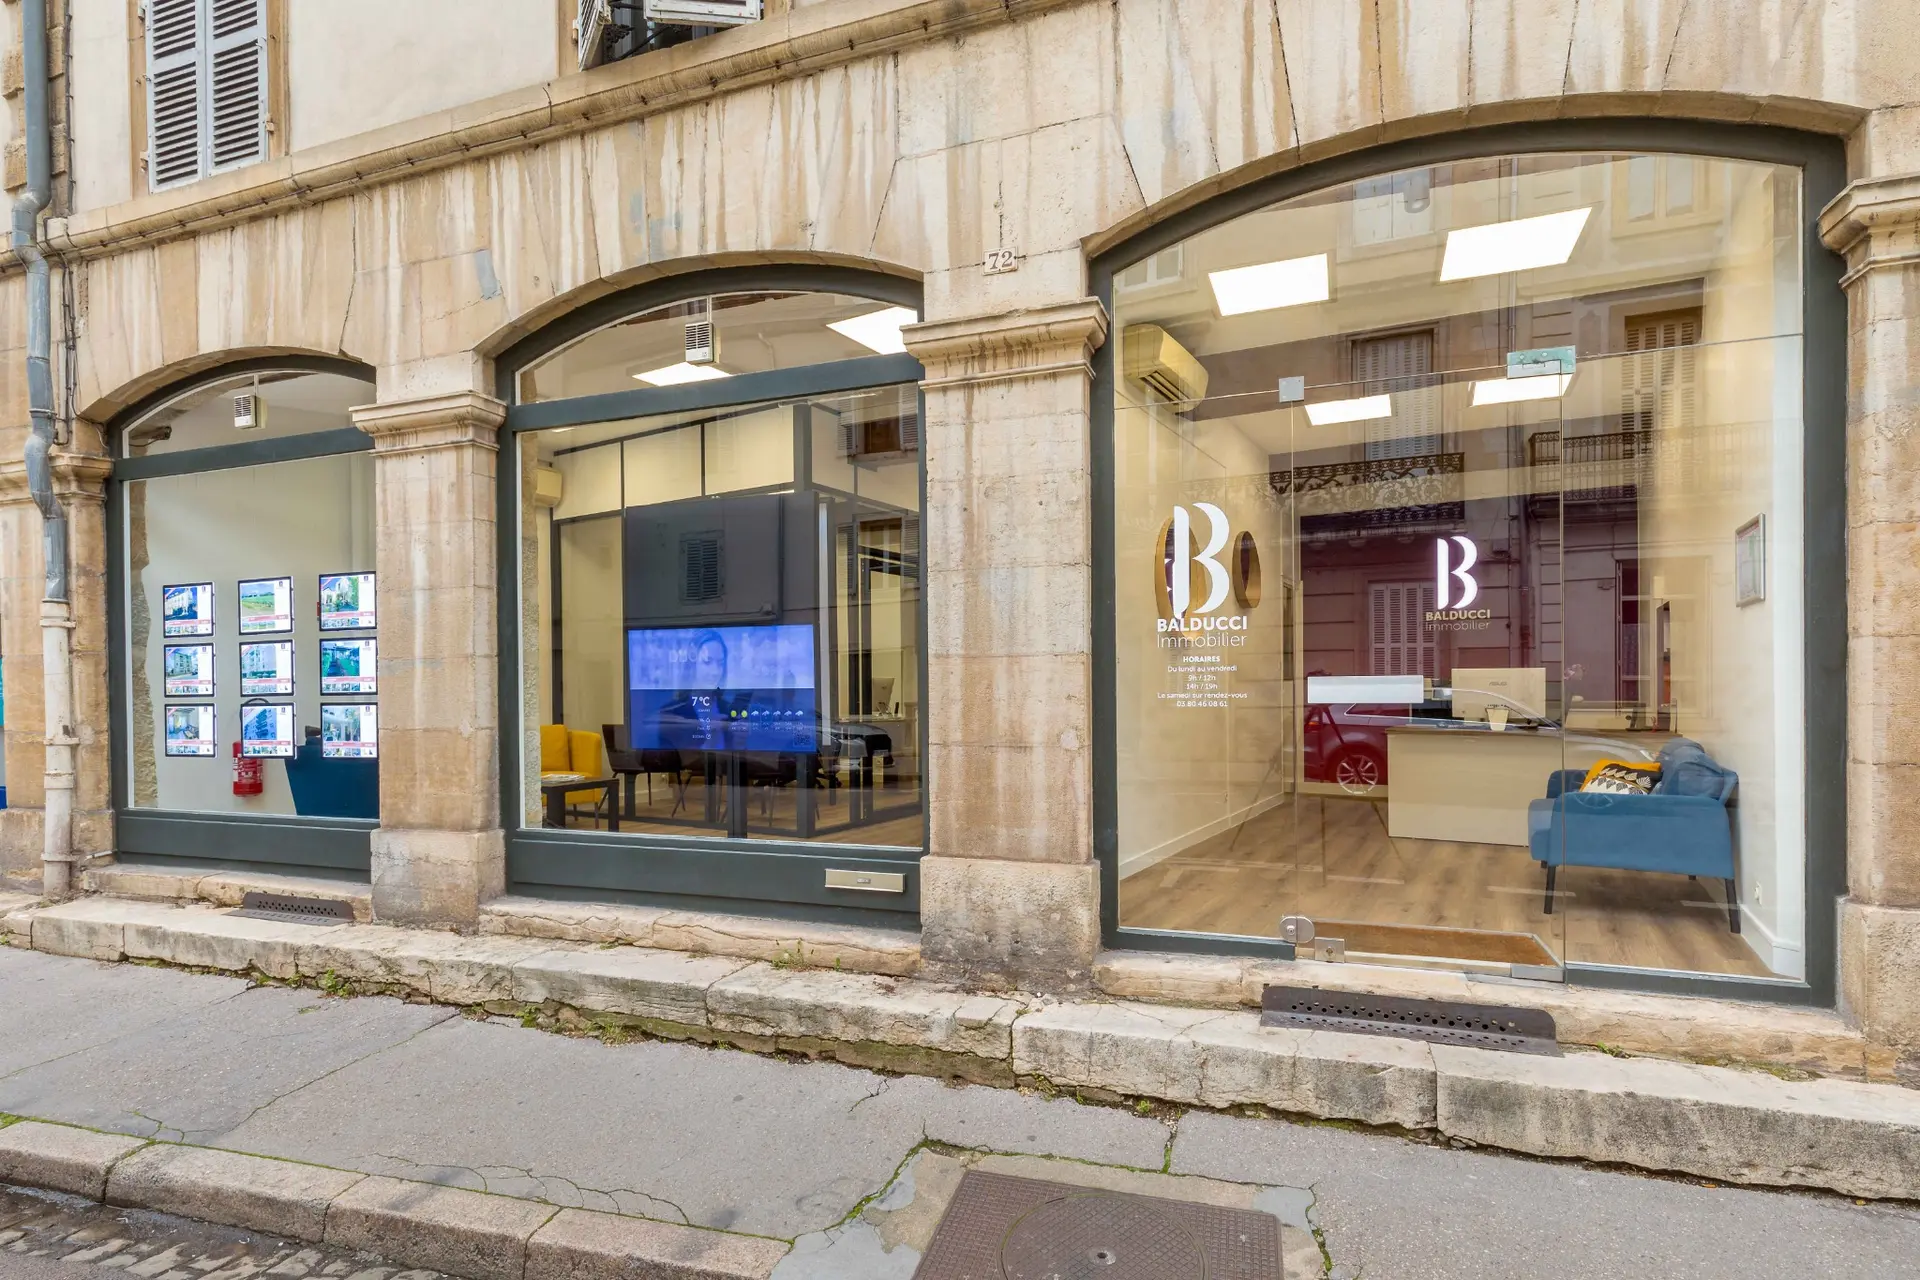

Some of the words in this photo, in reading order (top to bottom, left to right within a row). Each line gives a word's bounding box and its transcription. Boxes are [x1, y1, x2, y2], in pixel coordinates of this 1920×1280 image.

[988, 250, 1013, 270] 72
[1173, 502, 1230, 619] B
[1436, 535, 1478, 610] B
[1426, 609, 1491, 621] BALDUCCI
[1157, 616, 1248, 632] BALDUCCI
[1425, 620, 1490, 631] Immobilier
[1157, 632, 1248, 649] Immobilier
[1182, 655, 1221, 663] HORAIRES
[1167, 665, 1177, 673] Du
[1187, 674, 1197, 682] 9h
[1176, 700, 1186, 708] 03
